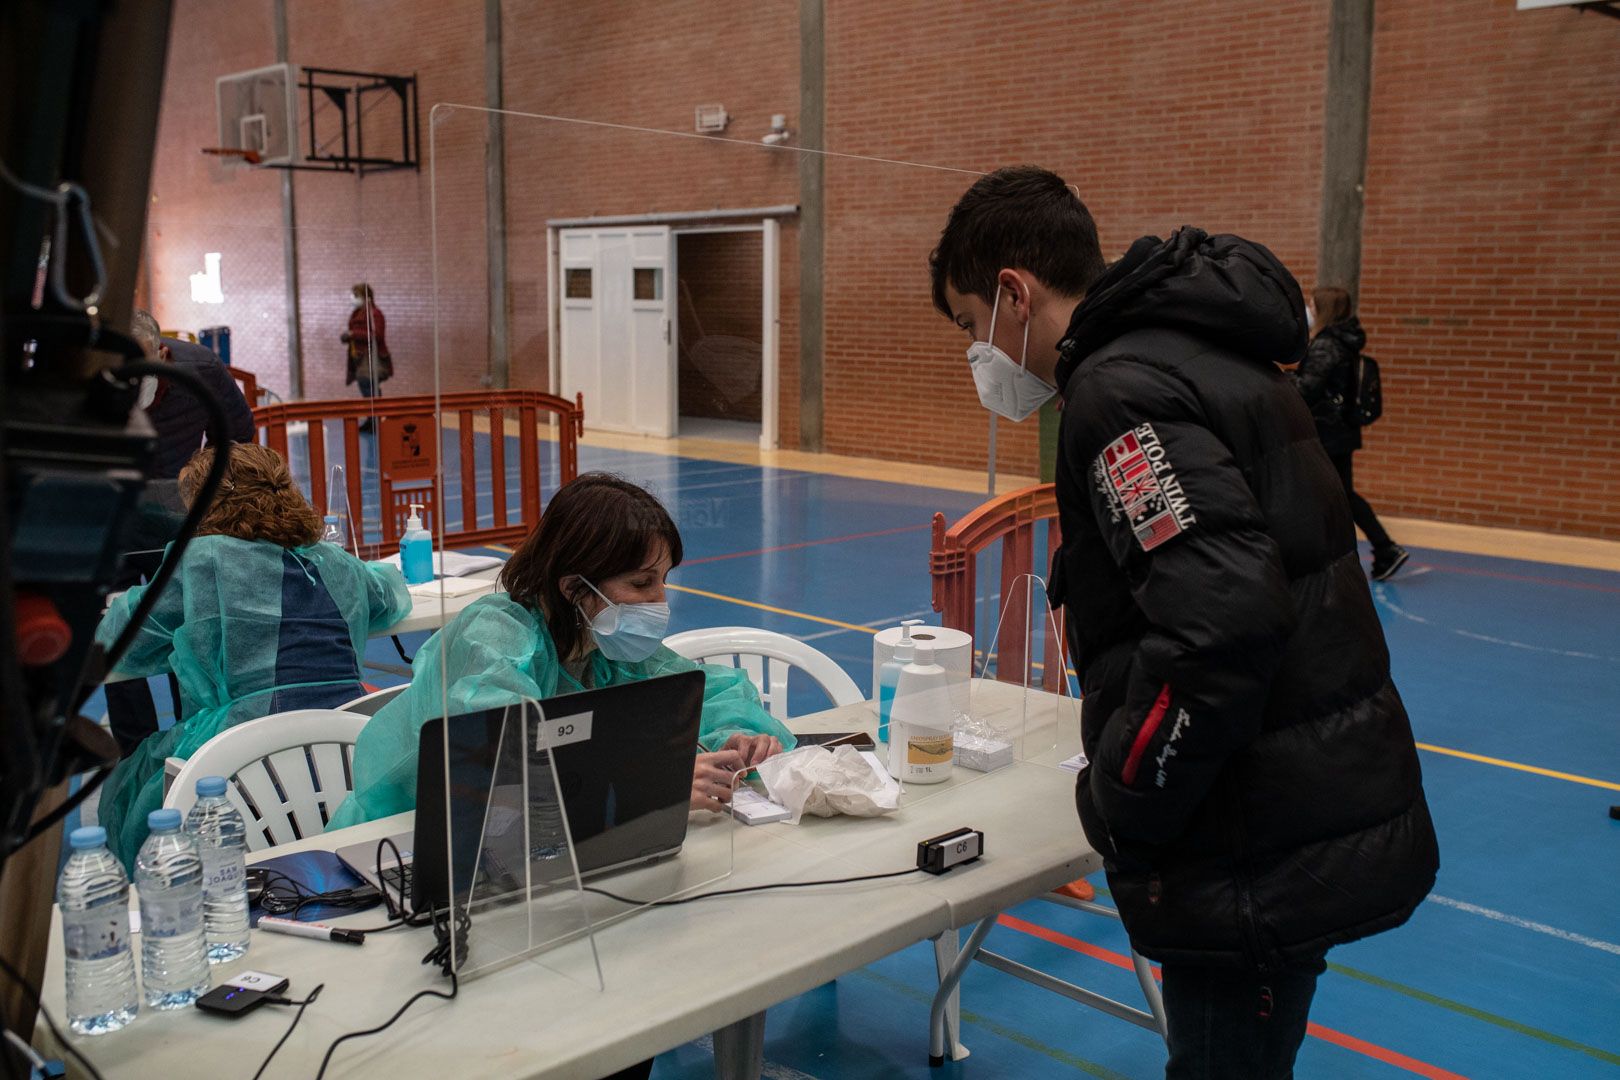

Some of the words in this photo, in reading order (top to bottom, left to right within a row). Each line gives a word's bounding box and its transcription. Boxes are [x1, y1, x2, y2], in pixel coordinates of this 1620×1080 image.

[1135, 422, 1172, 475] POLE
[1160, 474, 1197, 530] TWIN
[558, 723, 574, 737] C6
[956, 840, 968, 854] C6
